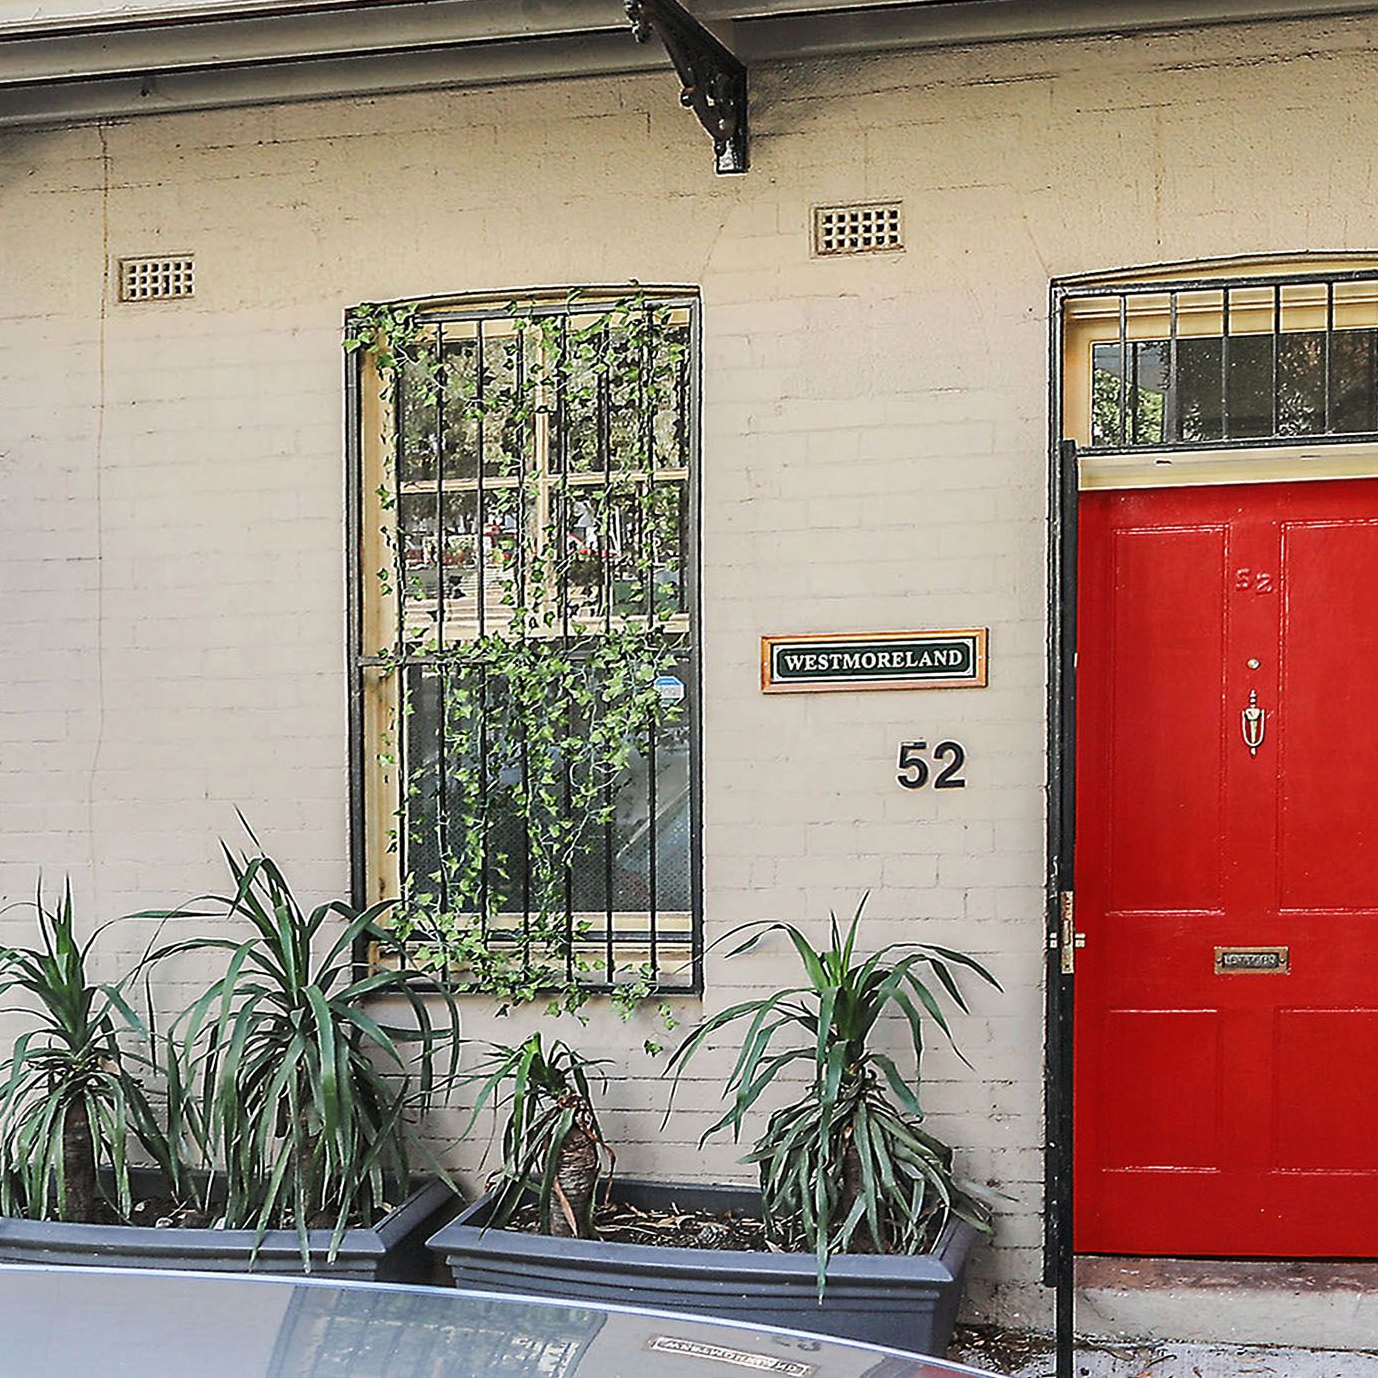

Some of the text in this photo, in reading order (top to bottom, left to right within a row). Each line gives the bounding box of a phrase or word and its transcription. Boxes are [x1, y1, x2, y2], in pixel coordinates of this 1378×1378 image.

[1234, 567, 1273, 595] 52
[784, 648, 964, 672] WESTMORELAND
[897, 740, 966, 791] 52
